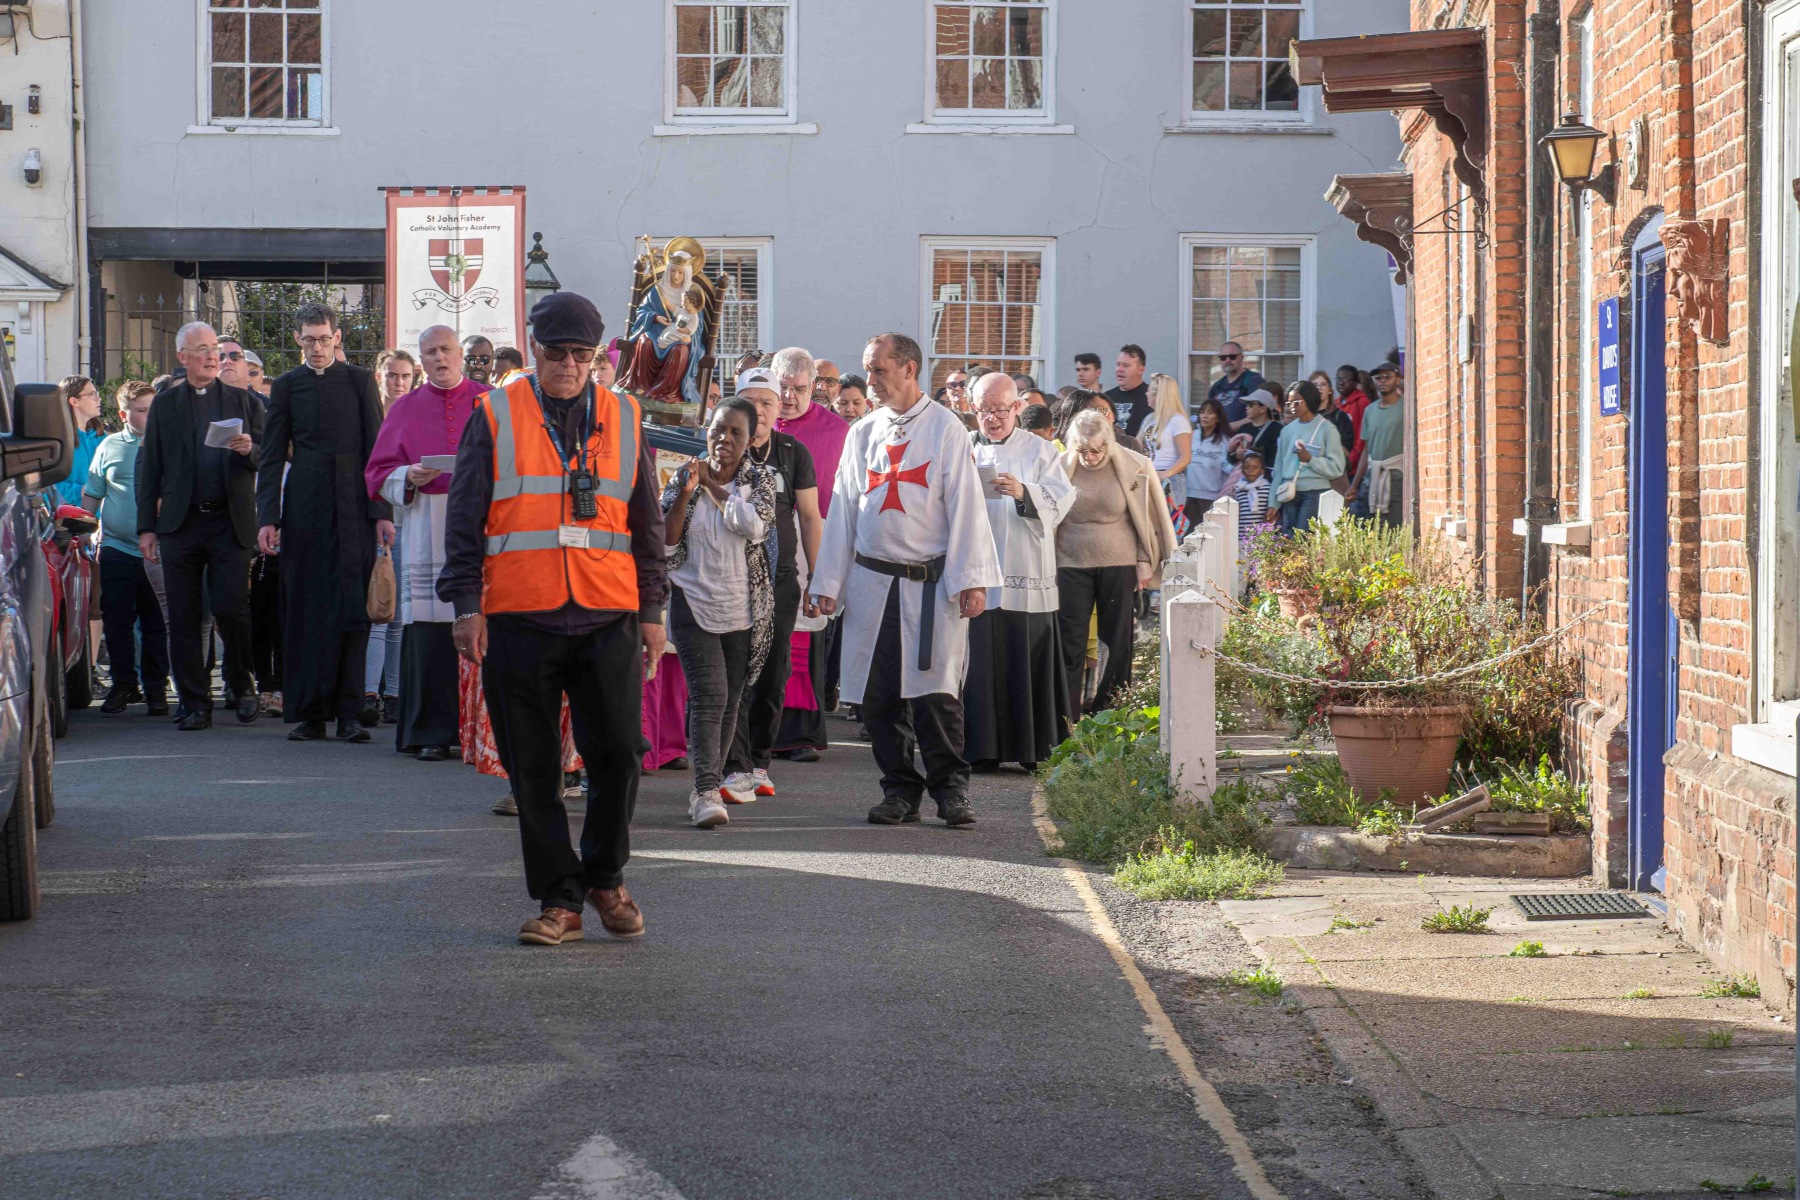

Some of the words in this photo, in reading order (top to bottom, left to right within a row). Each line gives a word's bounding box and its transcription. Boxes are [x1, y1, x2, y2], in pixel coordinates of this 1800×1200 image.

[426, 215, 435, 223] St
[437, 214, 459, 223] John
[460, 213, 485, 222] Fisher
[438, 224, 468, 232] Voluntary
[470, 224, 501, 232] Academy
[480, 326, 508, 335] Respect
[1604, 385, 1617, 409] HOUSE
